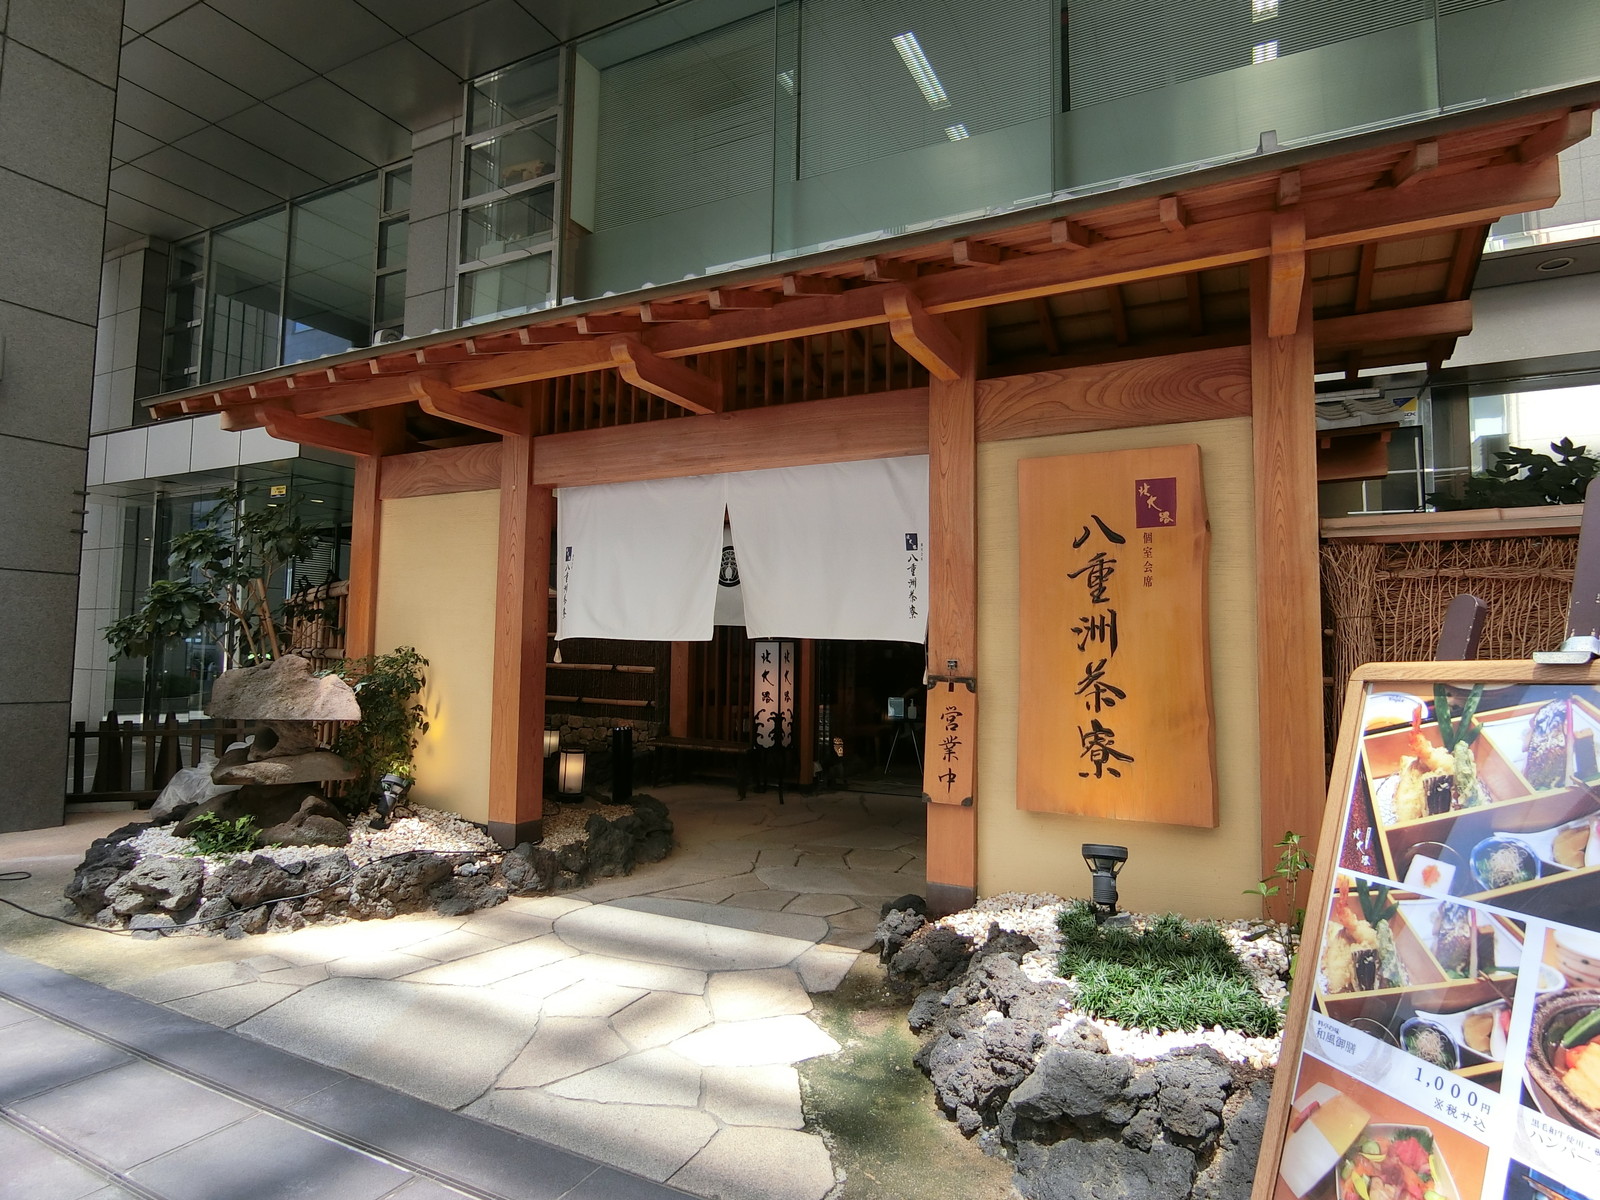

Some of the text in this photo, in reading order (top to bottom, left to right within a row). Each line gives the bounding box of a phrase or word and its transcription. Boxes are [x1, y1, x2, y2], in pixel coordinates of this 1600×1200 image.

[1143, 532, 1153, 588] 個室会席
[1067, 514, 1135, 779] 八重洲茶寮
[938, 705, 963, 794] 営業中
[1316, 1027, 1357, 1056] 和風御膳
